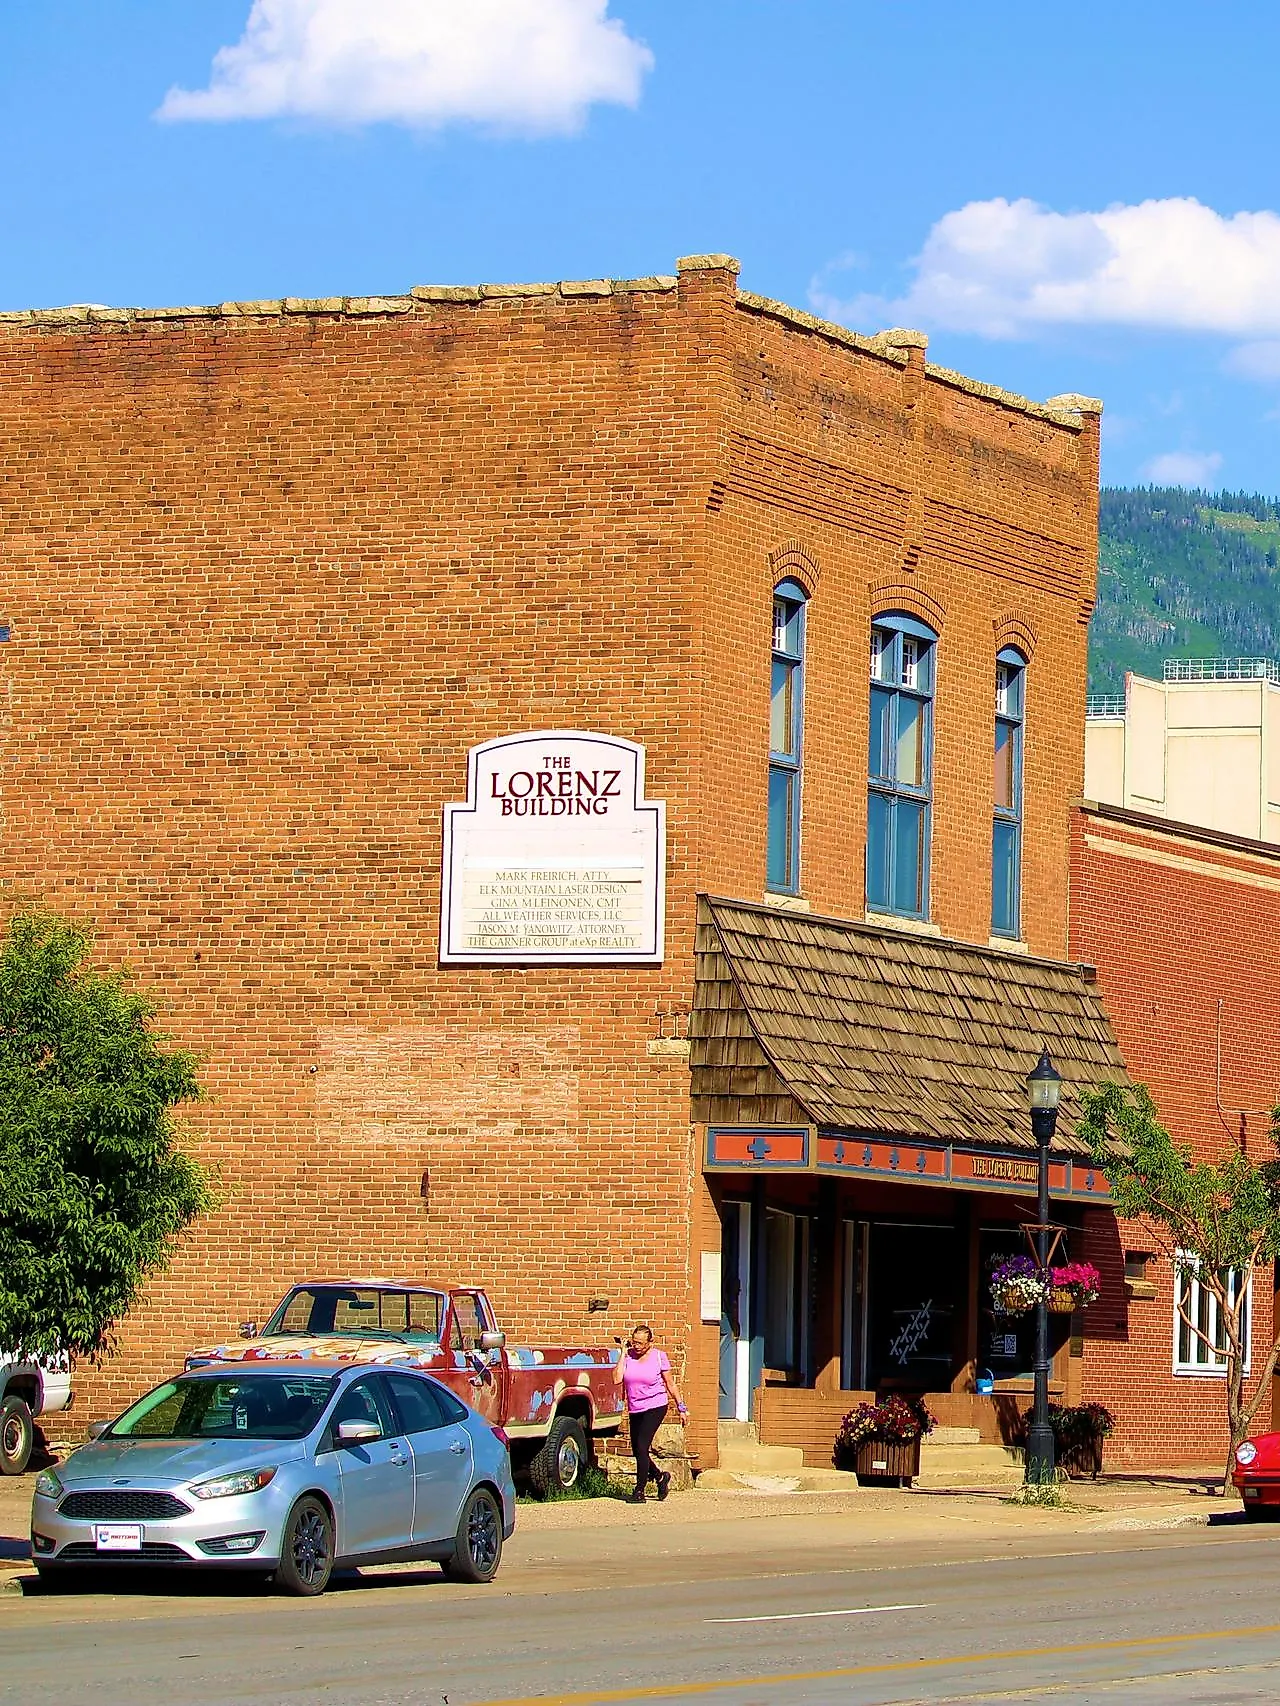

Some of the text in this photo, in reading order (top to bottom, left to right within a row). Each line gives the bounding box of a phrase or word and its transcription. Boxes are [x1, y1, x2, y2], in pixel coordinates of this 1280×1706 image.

[543, 756, 571, 769] THE
[491, 770, 621, 798] LORENZ
[501, 798, 608, 816] BUILDING
[495, 871, 528, 881] MARK
[479, 884, 628, 895] ELK MOUNTAIN LASER DESIGN
[490, 898, 518, 908] GINA
[596, 898, 622, 908] CMT
[483, 911, 501, 921] ALL
[503, 911, 552, 921] WEATHER
[603, 911, 623, 920] LLC
[478, 924, 508, 934] JASON
[578, 924, 626, 934] ATTORNEY
[468, 937, 487, 947] THE
[489, 937, 532, 947] GARNER
[533, 937, 569, 947] GROUP
[599, 937, 636, 947] REALTY
[972, 1158, 986, 1176] THE
